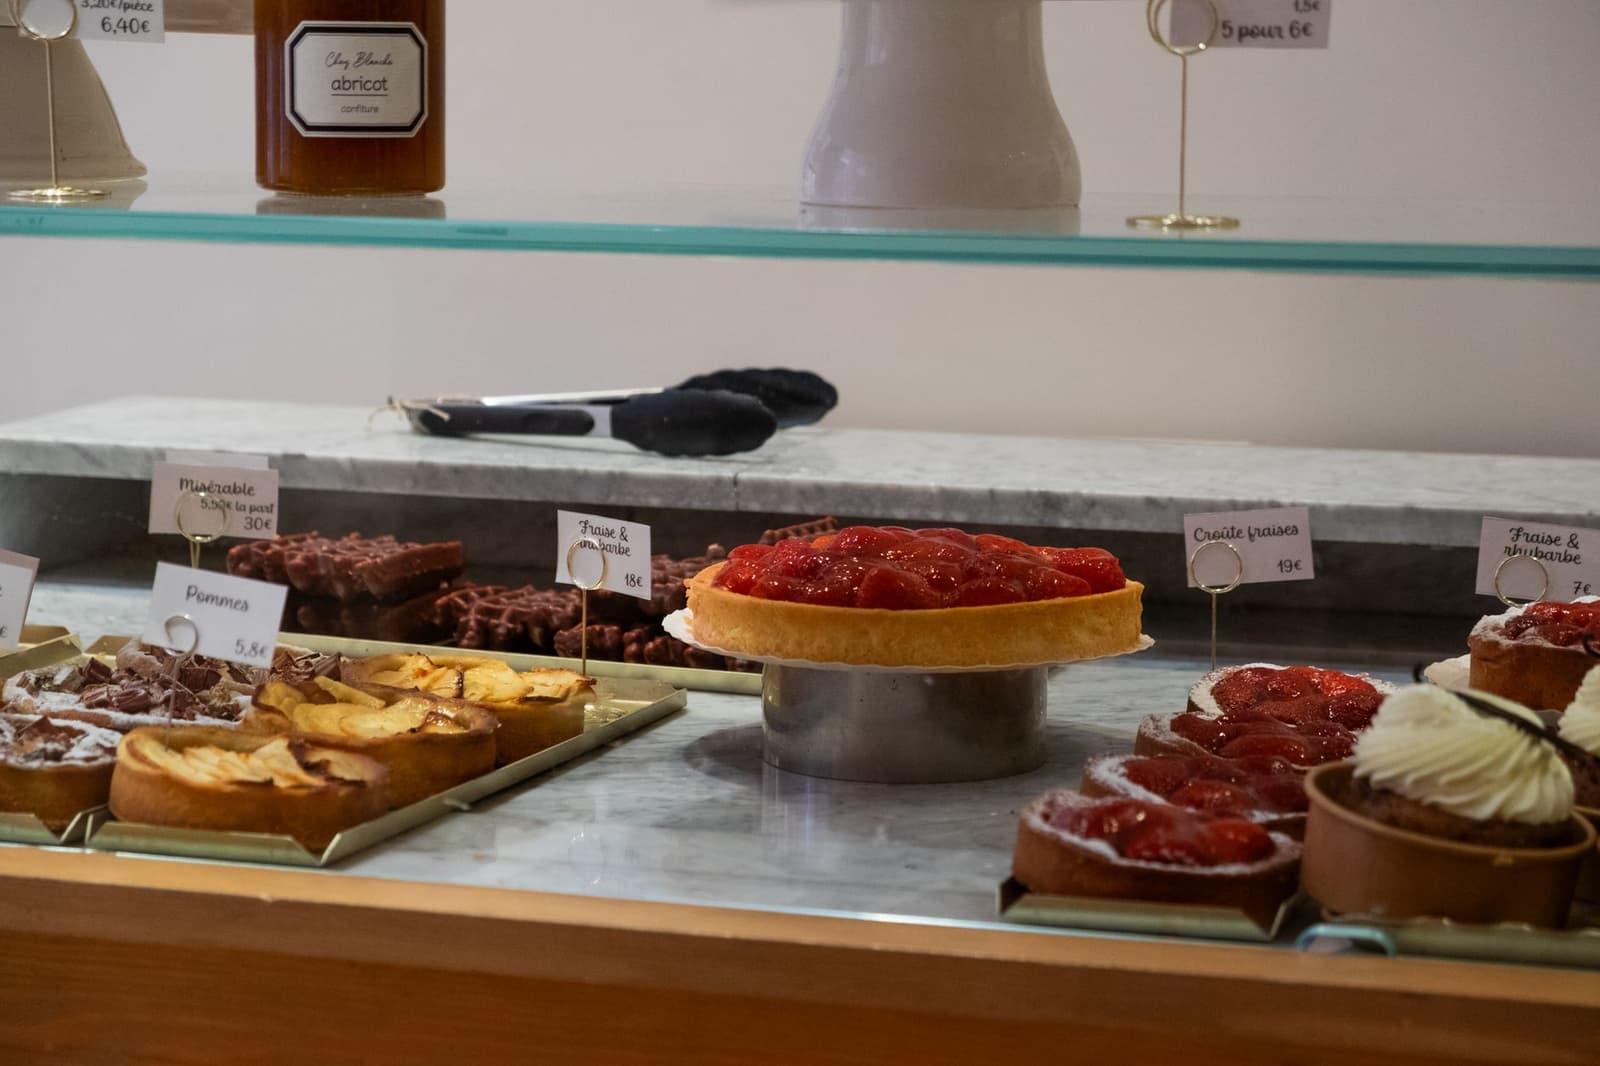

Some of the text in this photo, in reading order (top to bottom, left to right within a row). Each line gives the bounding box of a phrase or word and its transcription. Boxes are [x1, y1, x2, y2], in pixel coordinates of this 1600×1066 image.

[101, 16, 151, 34] 6,40€
[1221, 19, 1313, 43] 5 pour 6€
[331, 75, 388, 91] abricot
[340, 104, 379, 113] confiture
[179, 477, 255, 496] Misérable
[235, 500, 246, 513] la
[248, 502, 274, 515] part
[243, 516, 272, 531] 30€
[579, 520, 629, 543] Fraise &
[1193, 524, 1299, 542] Croûte fraises
[1509, 527, 1580, 549] Fraise &
[1503, 544, 1582, 565] rhubarbe
[1276, 559, 1303, 573] 19€
[624, 573, 643, 588] 18€
[1573, 581, 1592, 596] 7€
[186, 584, 249, 612] Pommes
[234, 639, 267, 658] 5,8€
